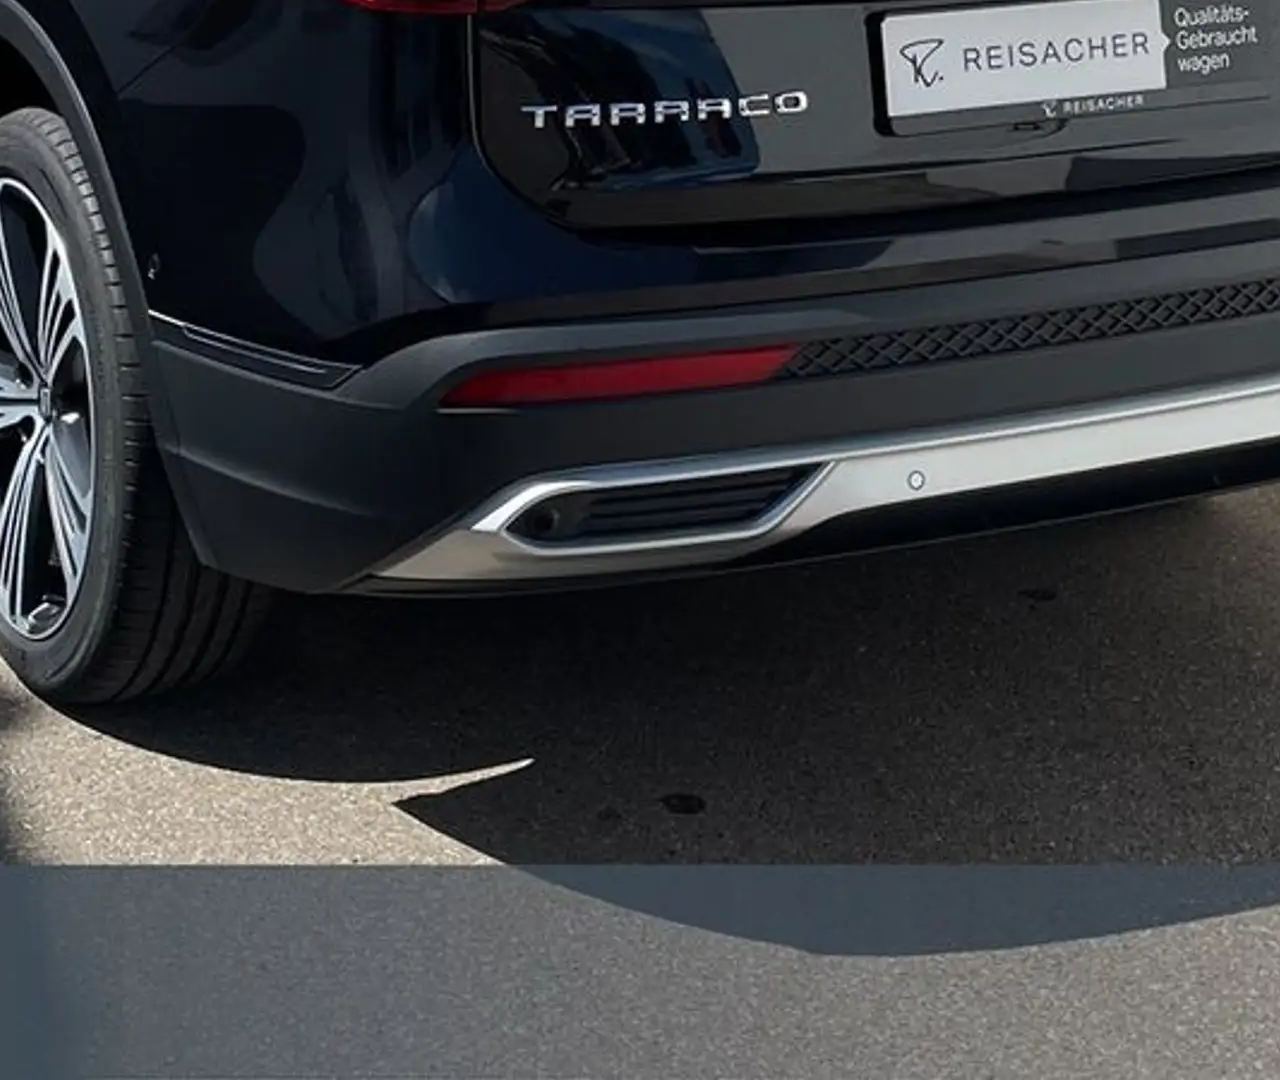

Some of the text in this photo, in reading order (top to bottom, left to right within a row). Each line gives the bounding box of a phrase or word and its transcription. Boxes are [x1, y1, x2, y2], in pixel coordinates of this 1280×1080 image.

[1173, 4, 1250, 29] Qualitäts-
[1175, 25, 1259, 51] Gebraucht
[963, 32, 1150, 71] REISACHER
[1176, 52, 1231, 76] wagen
[520, 90, 809, 129] TARRACO
[1061, 93, 1145, 116] REISACHER
